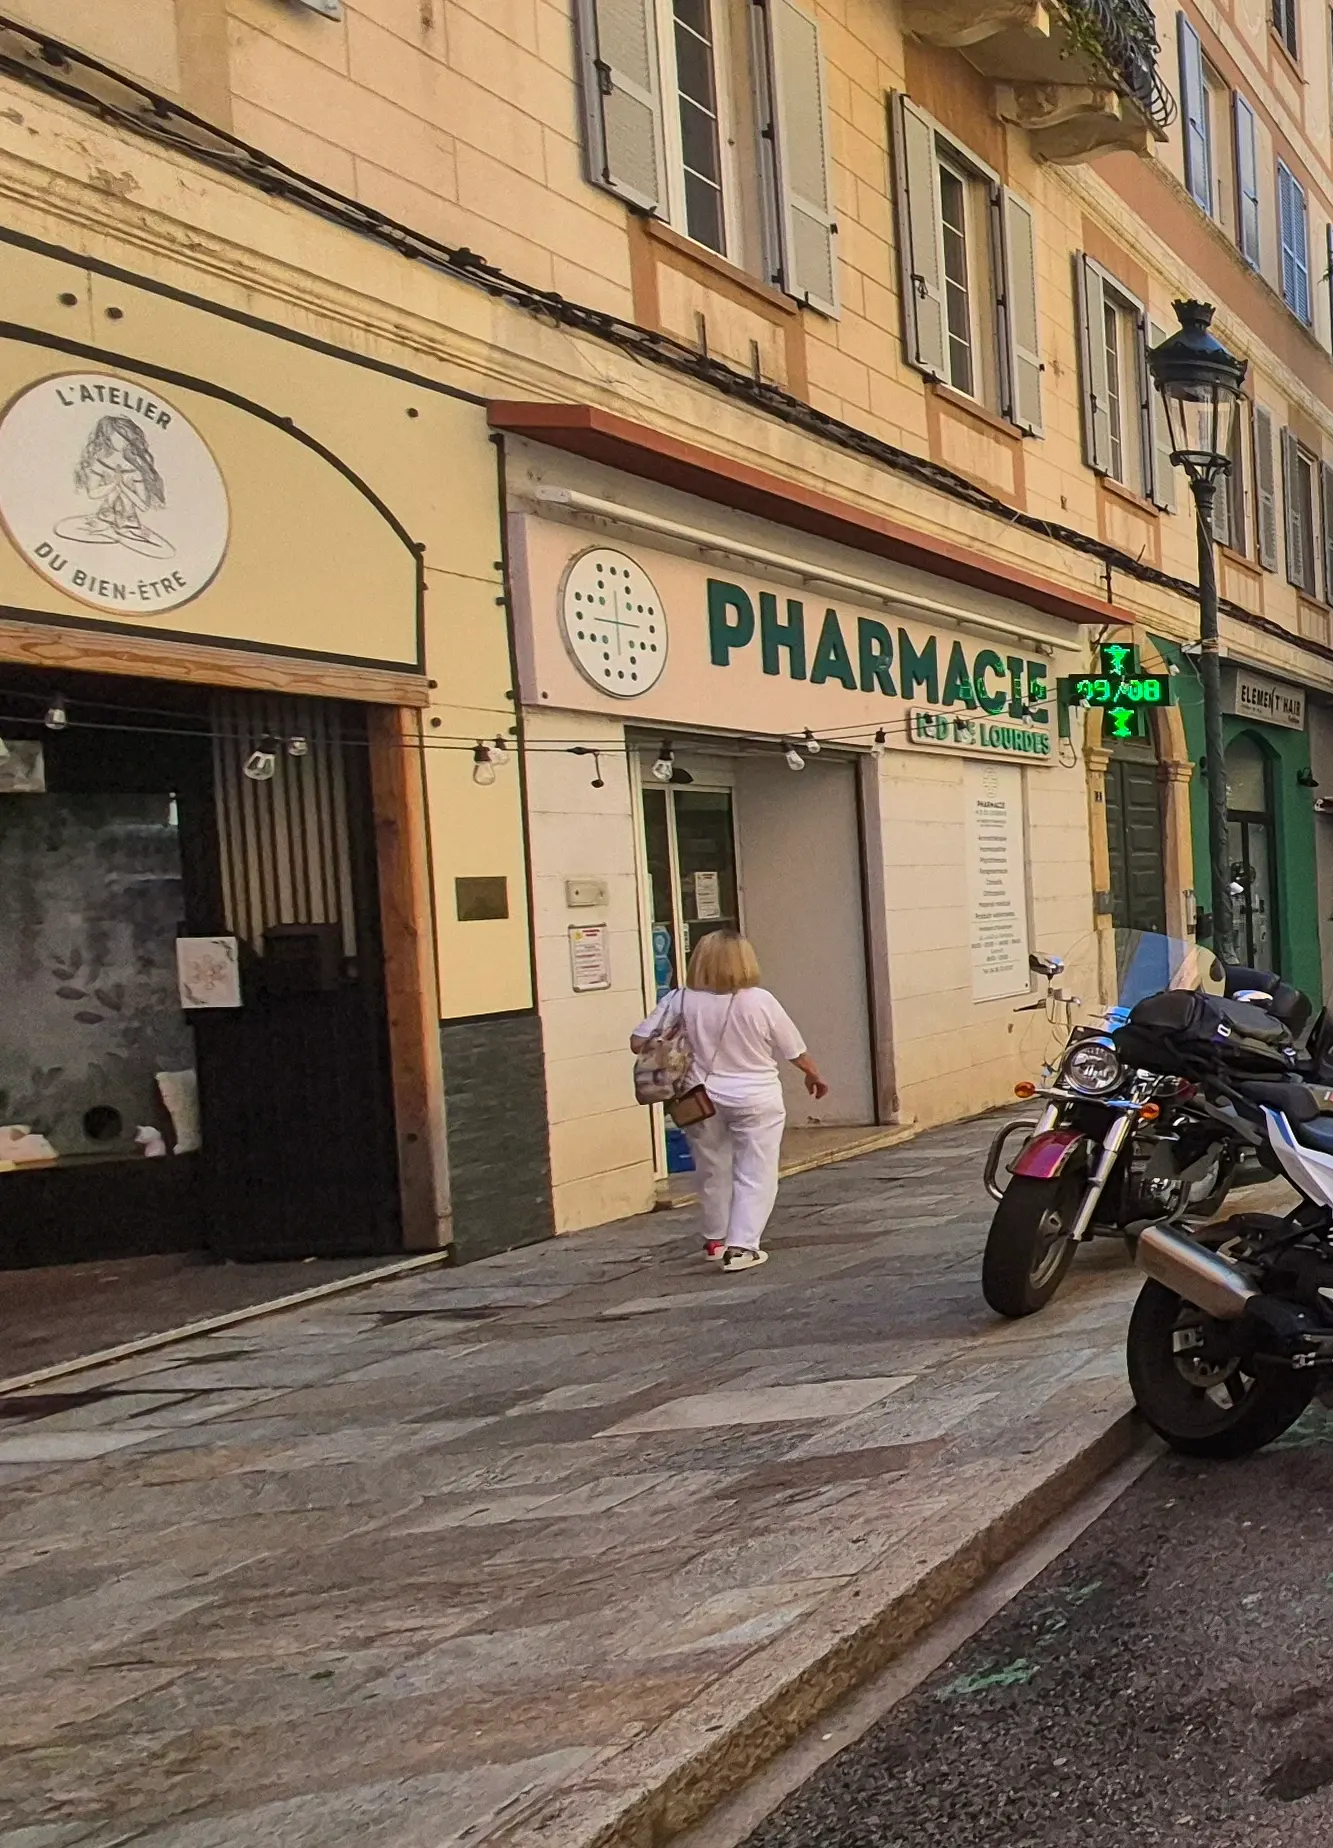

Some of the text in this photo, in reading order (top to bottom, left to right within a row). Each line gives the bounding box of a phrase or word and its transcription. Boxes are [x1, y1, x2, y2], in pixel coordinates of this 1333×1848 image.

[56, 384, 173, 430] L'ATELIER
[34, 541, 187, 601] DU BIEN-ÊTRE
[707, 577, 1049, 724] PHARMACIE
[980, 723, 1051, 755] LOURDES
